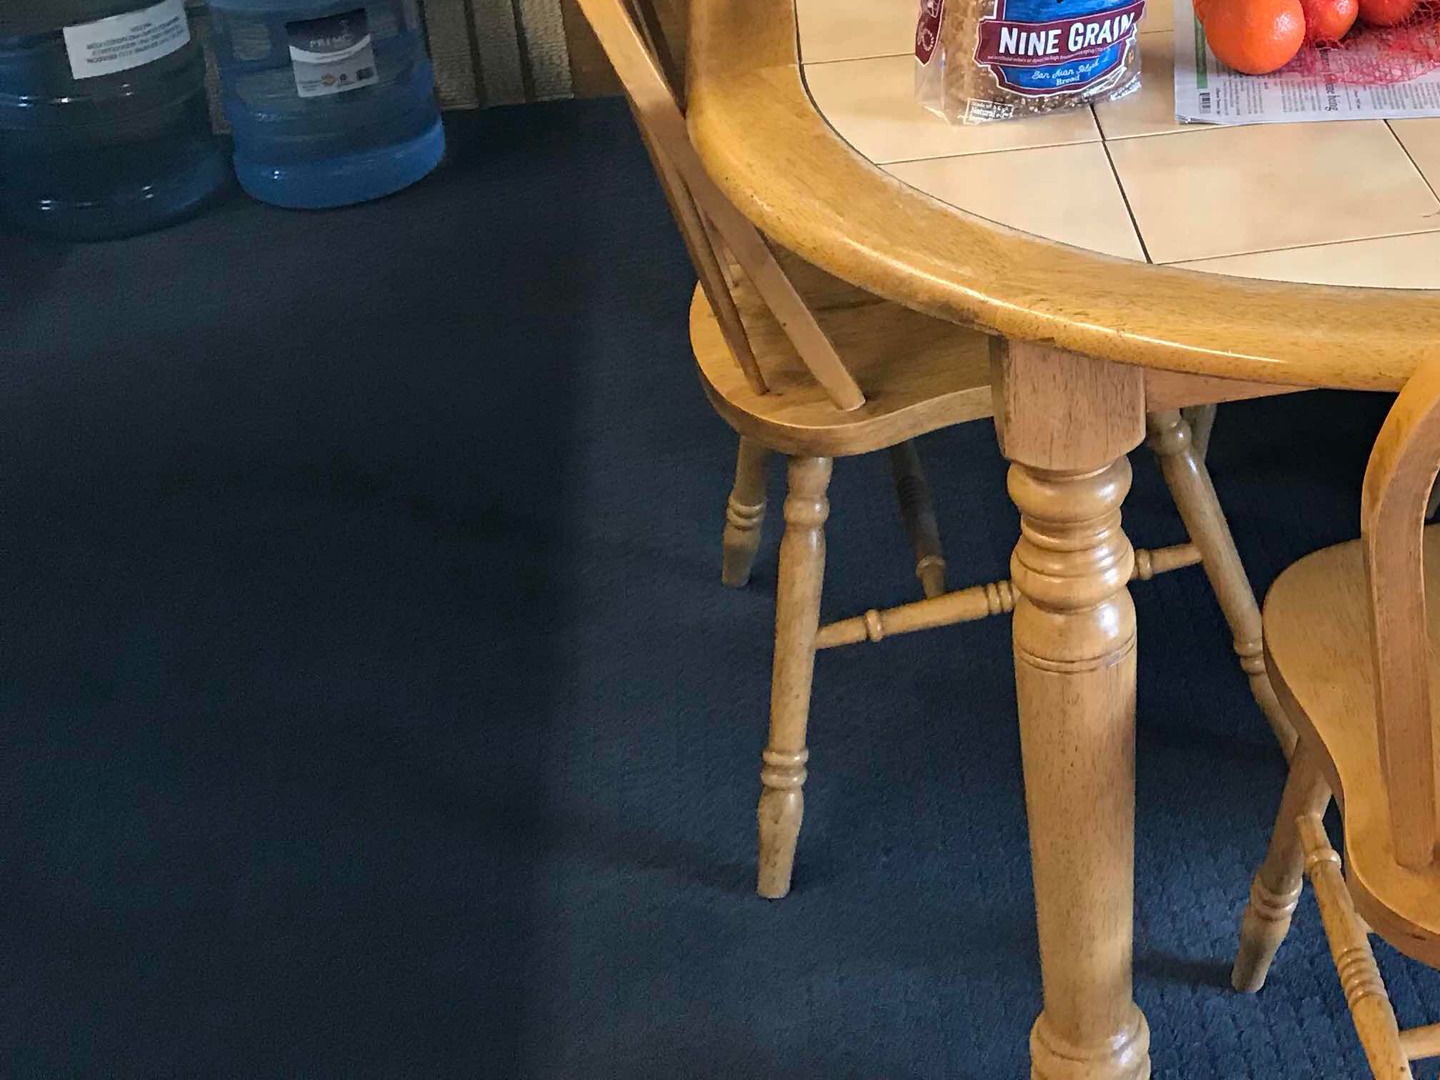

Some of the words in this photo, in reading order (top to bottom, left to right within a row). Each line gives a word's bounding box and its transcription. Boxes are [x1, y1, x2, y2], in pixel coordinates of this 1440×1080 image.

[999, 26, 1062, 57] NINE
[1067, 11, 1136, 53] GRAIN
[1032, 70, 1050, 80] San
[1052, 68, 1075, 78] Juan
[1056, 76, 1080, 86] Bread
